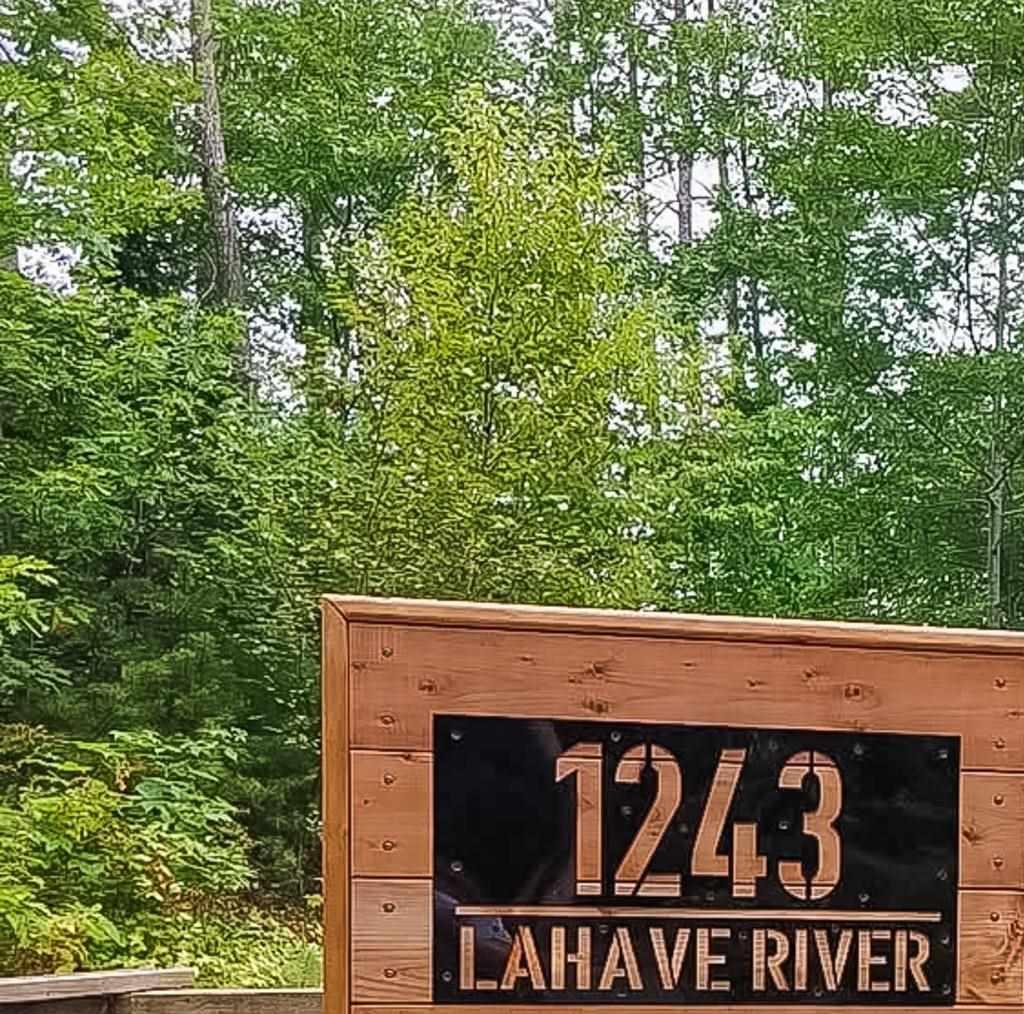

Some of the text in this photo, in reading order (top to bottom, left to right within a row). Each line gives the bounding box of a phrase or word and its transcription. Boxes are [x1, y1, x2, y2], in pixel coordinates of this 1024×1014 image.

[555, 742, 843, 900] 1243
[458, 926, 932, 992] LAHAVE RIVER
